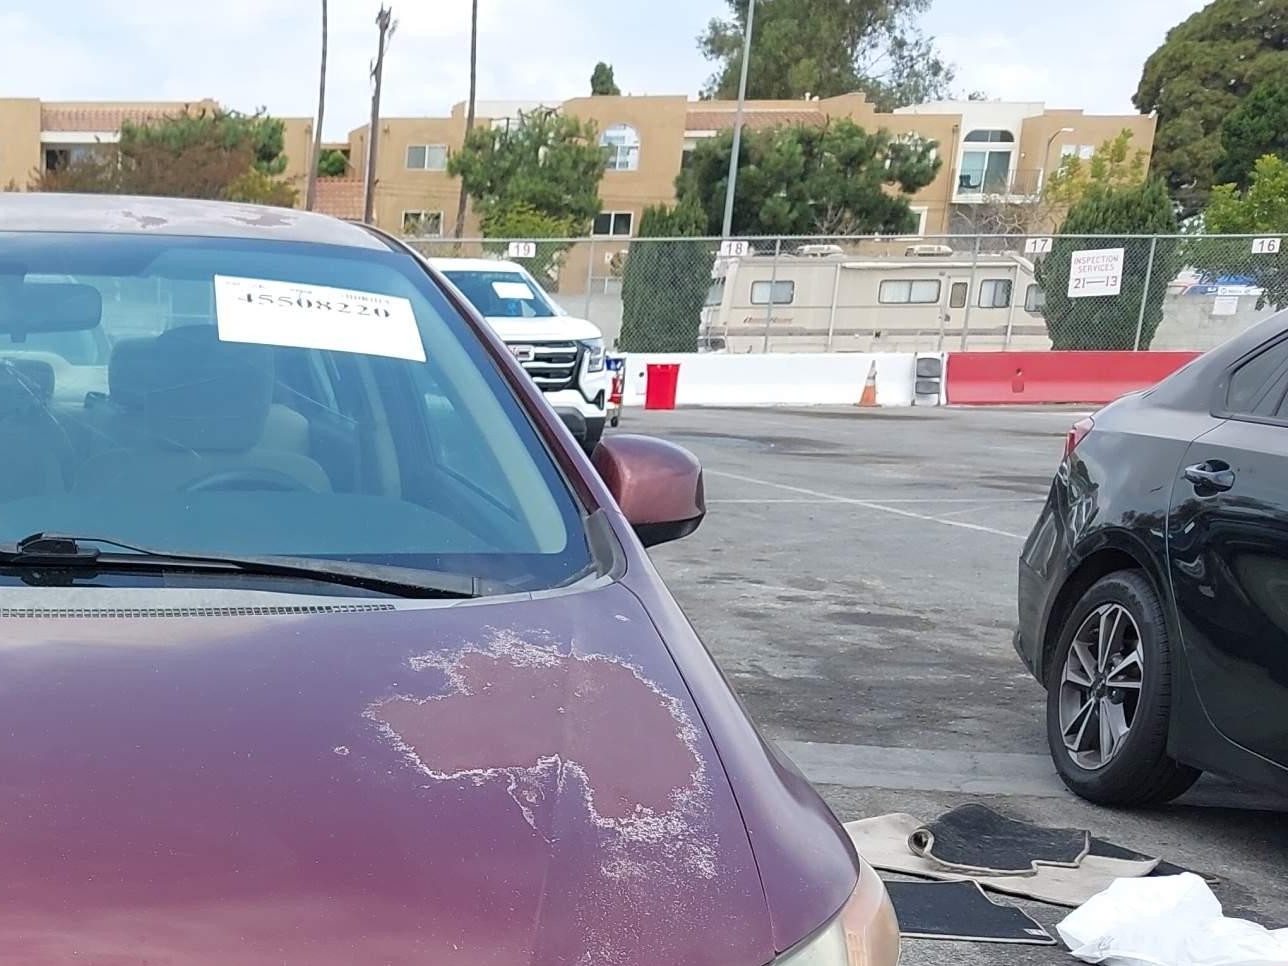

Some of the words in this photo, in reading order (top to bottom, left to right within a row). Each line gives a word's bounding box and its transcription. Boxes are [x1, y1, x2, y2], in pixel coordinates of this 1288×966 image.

[513, 242, 531, 256] 19
[725, 242, 743, 256] 18
[1031, 238, 1048, 252] 17
[1258, 239, 1276, 252] 16
[1074, 255, 1119, 265] INSPECTION
[1078, 263, 1114, 273] SERVICES
